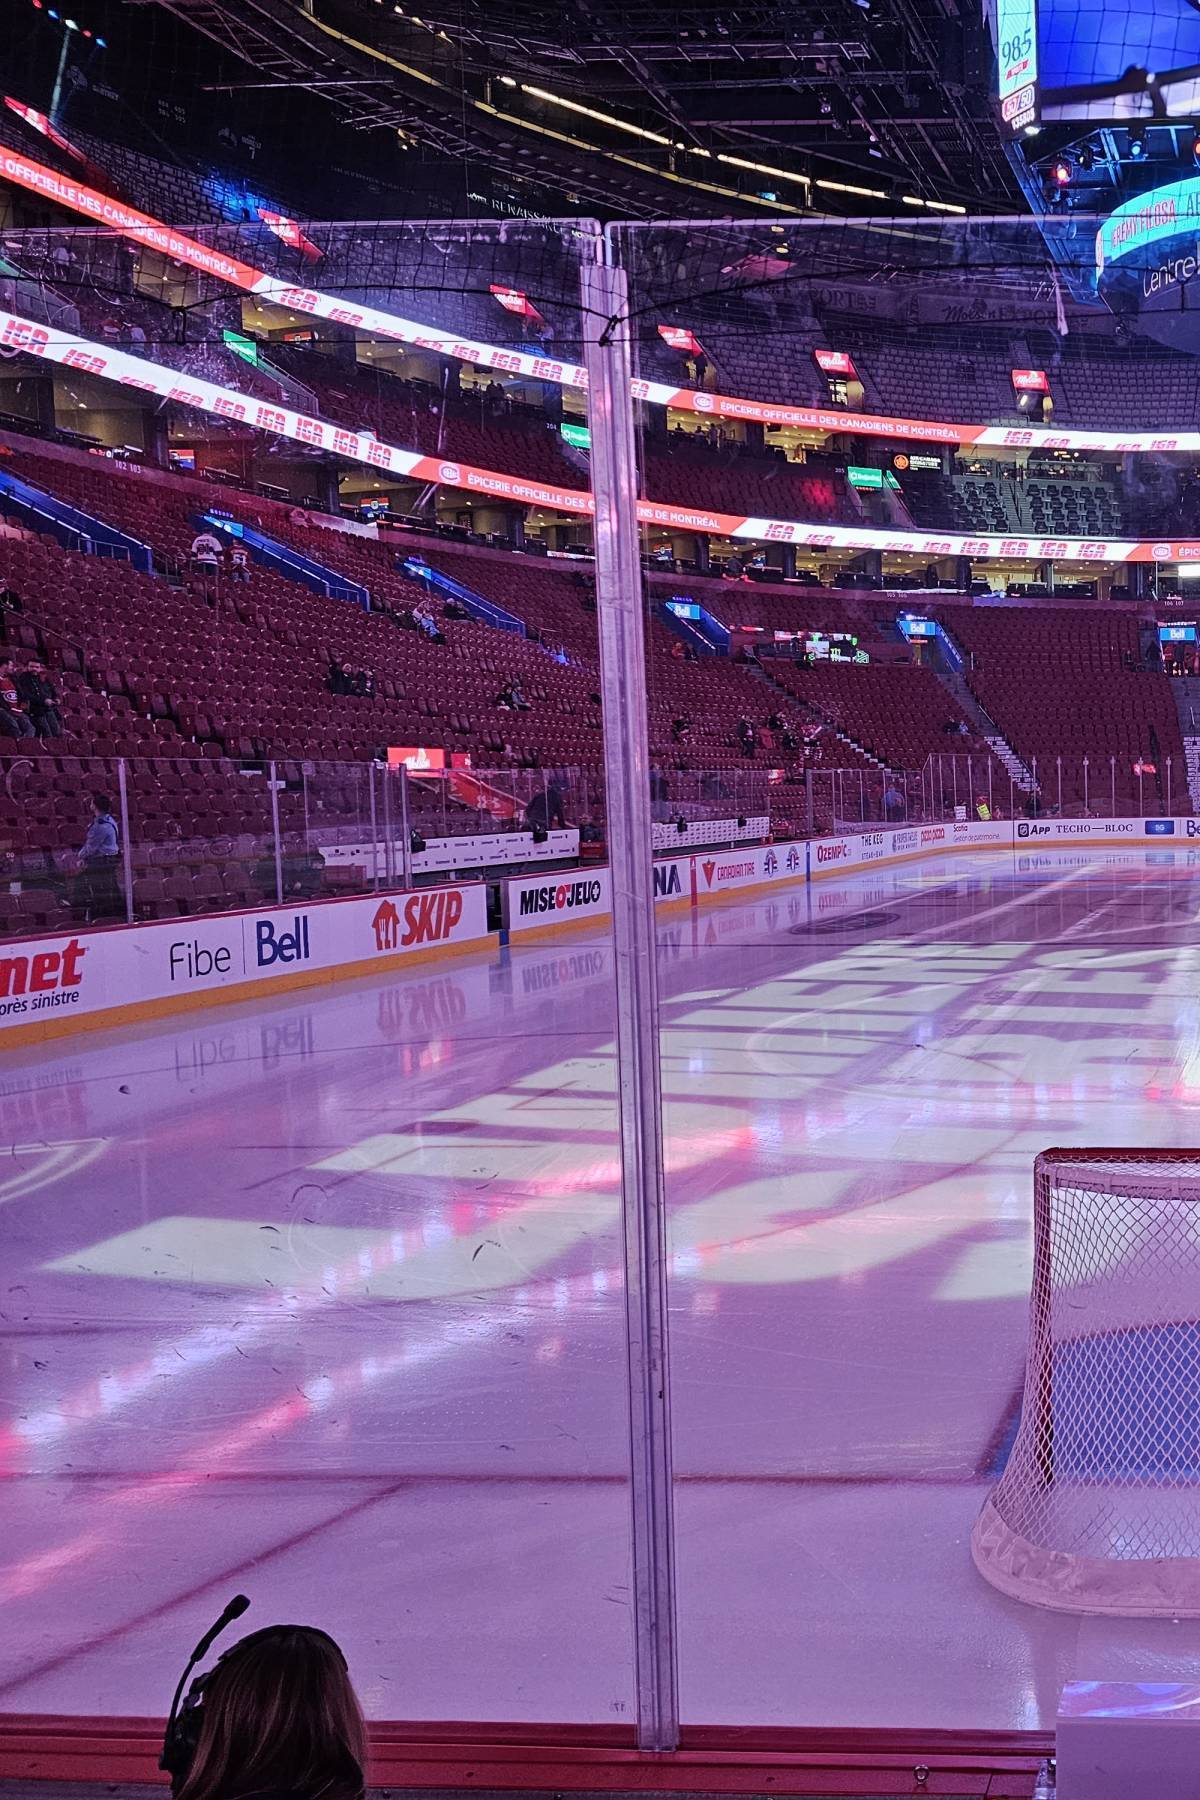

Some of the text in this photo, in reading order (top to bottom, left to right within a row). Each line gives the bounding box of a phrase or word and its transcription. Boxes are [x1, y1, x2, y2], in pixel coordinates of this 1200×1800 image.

[1002, 28, 1032, 68] 98.5
[5, 163, 76, 202] OFFICIELLE
[77, 192, 101, 215] DES
[103, 205, 169, 247] CANADIENS
[170, 234, 185, 255] DE
[186, 247, 238, 279] MONTRÉAL
[1140, 199, 1176, 232] FILOSA
[452, 345, 480, 361] IGA
[490, 351, 522, 371] IGA
[532, 360, 563, 380] IGA
[0, 320, 50, 355] IGA
[61, 349, 107, 375] IGA
[213, 397, 247, 421] IGA
[256, 406, 287, 433] IGA
[295, 415, 323, 446] IGA
[332, 430, 359, 456] IGA
[366, 442, 392, 467] IGA
[720, 400, 961, 439] ÉPICERIE OFFICIELLE DES CANADIENS DE MONTRÉAL
[1003, 431, 1033, 444] IGA
[115, 460, 141, 473] 102 103
[467, 473, 510, 494] ÉPICERIE
[512, 483, 563, 505] OFFICIELLE
[564, 495, 585, 509] DES
[655, 509, 669, 521] DE
[670, 509, 721, 529] MONTRÉAL
[764, 523, 796, 541] IGA
[960, 541, 990, 556] IGA
[1000, 541, 1030, 557] IGA
[1039, 542, 1069, 557] IGA
[1078, 543, 1107, 558] IGA
[674, 605, 691, 617] Bell
[910, 623, 926, 633] Bell
[1170, 629, 1185, 639] Bell
[862, 835, 872, 846] THE
[873, 833, 884, 846] KEG
[953, 824, 968, 833] Scotia
[817, 840, 851, 863] OZEMPIC
[653, 864, 682, 897] NA
[717, 861, 755, 881] CANADIAN TIRE
[401, 890, 464, 946] SKIP
[256, 915, 310, 967] Bell
[170, 940, 231, 981] Fibe
[0, 990, 80, 1015] près sinistre
